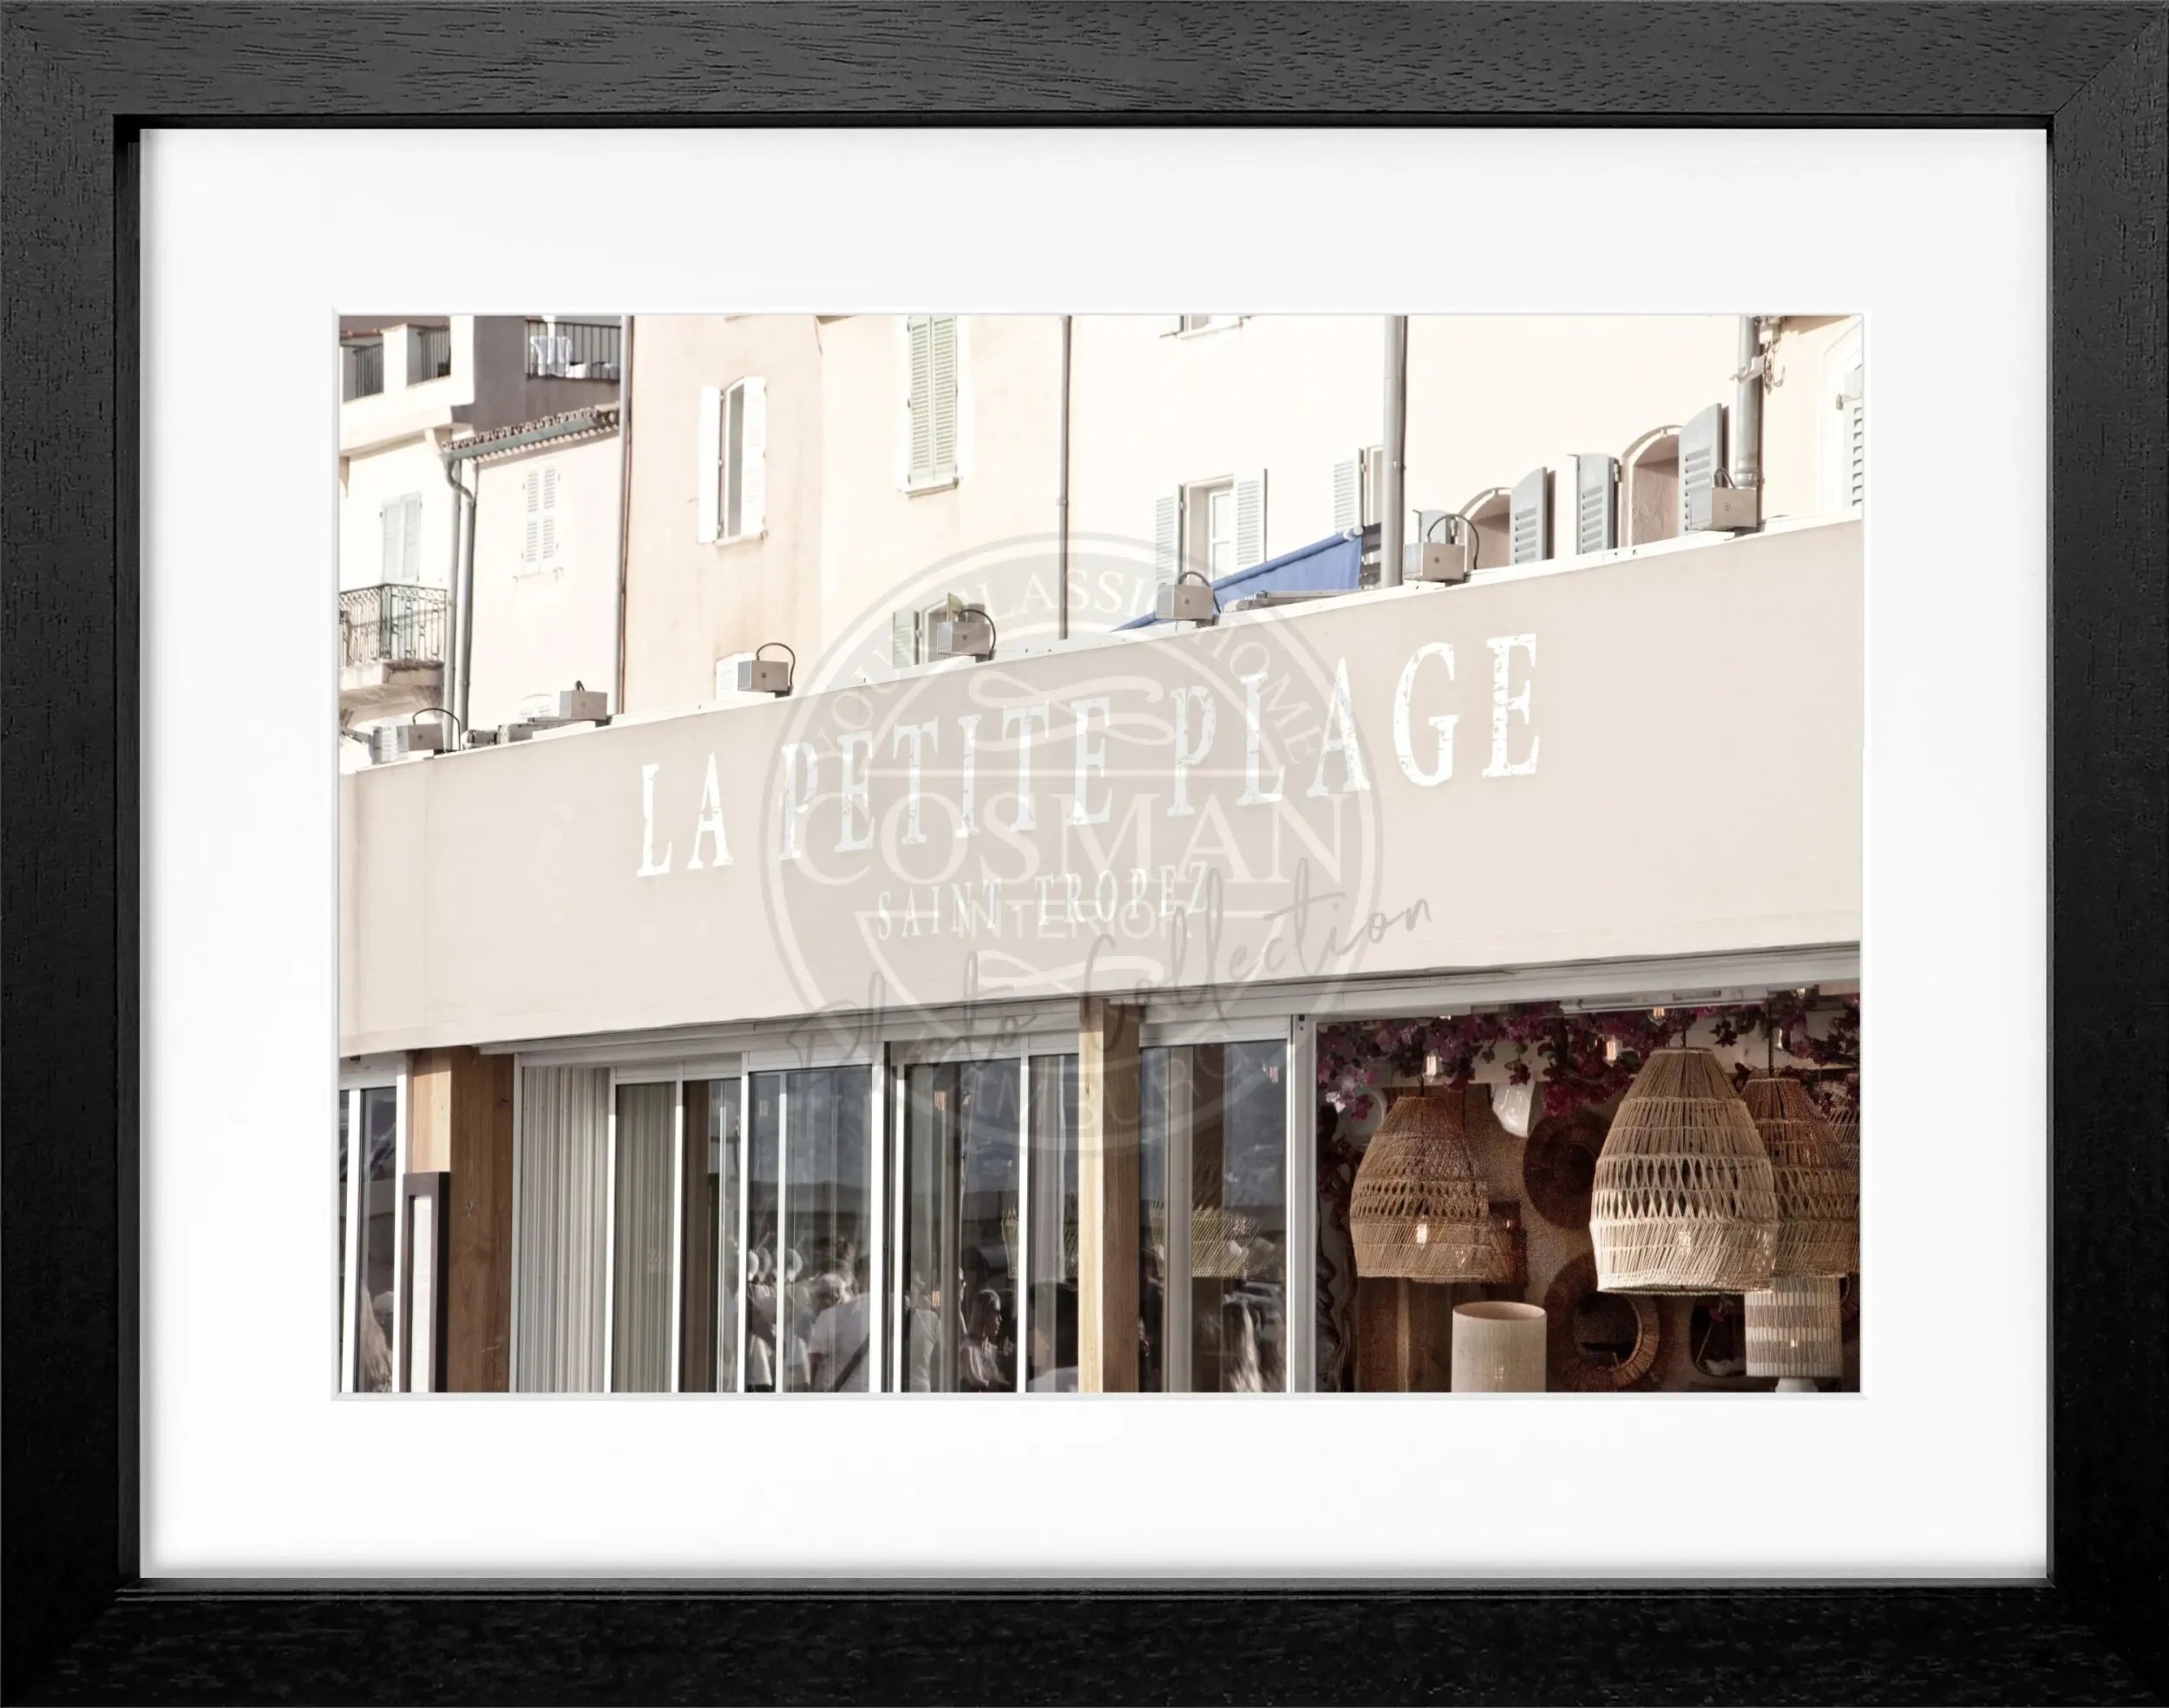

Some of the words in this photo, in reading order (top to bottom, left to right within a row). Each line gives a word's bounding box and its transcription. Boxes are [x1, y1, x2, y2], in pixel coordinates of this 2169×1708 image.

[637, 750, 733, 877] LA
[780, 697, 1113, 861] PETITE
[1167, 633, 1540, 816] PLAGE
